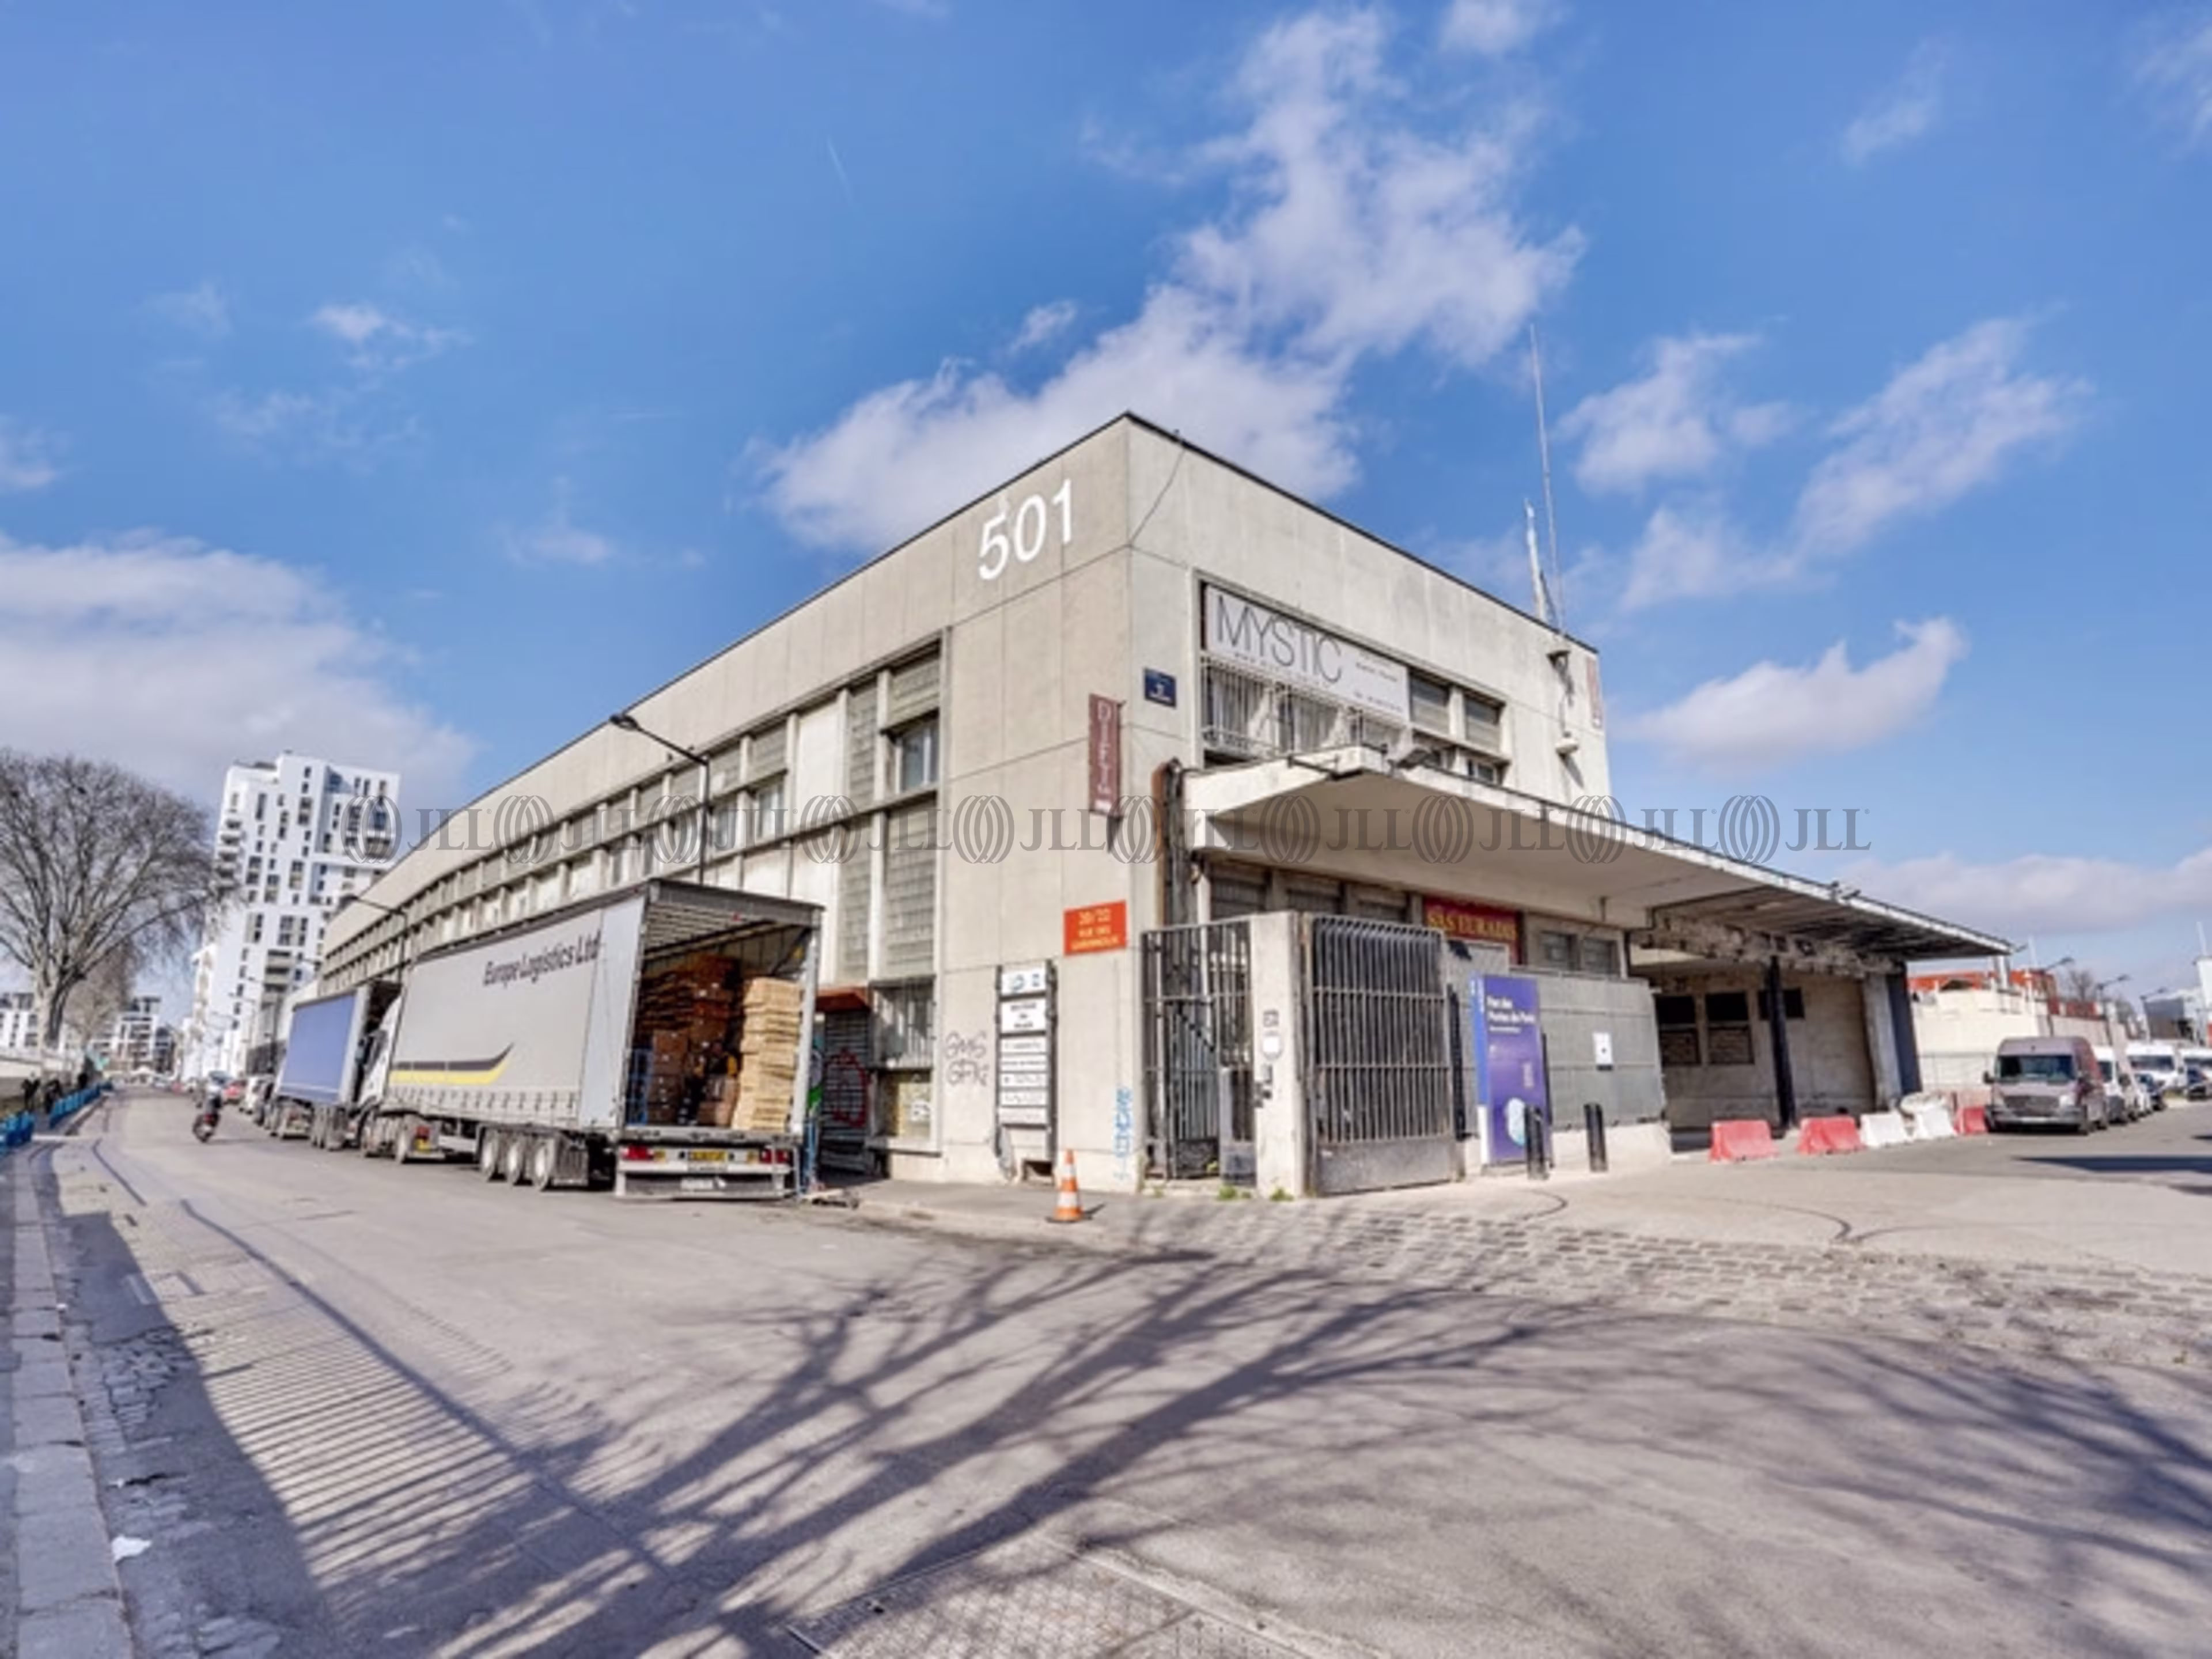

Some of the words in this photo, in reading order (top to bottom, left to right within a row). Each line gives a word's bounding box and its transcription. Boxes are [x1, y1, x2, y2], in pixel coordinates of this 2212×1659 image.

[979, 478, 1071, 581] 501
[1217, 594, 1343, 683] MYSTIC
[483, 959, 521, 989] Europe
[519, 944, 575, 983] Logistics
[577, 929, 601, 963] Ltd
